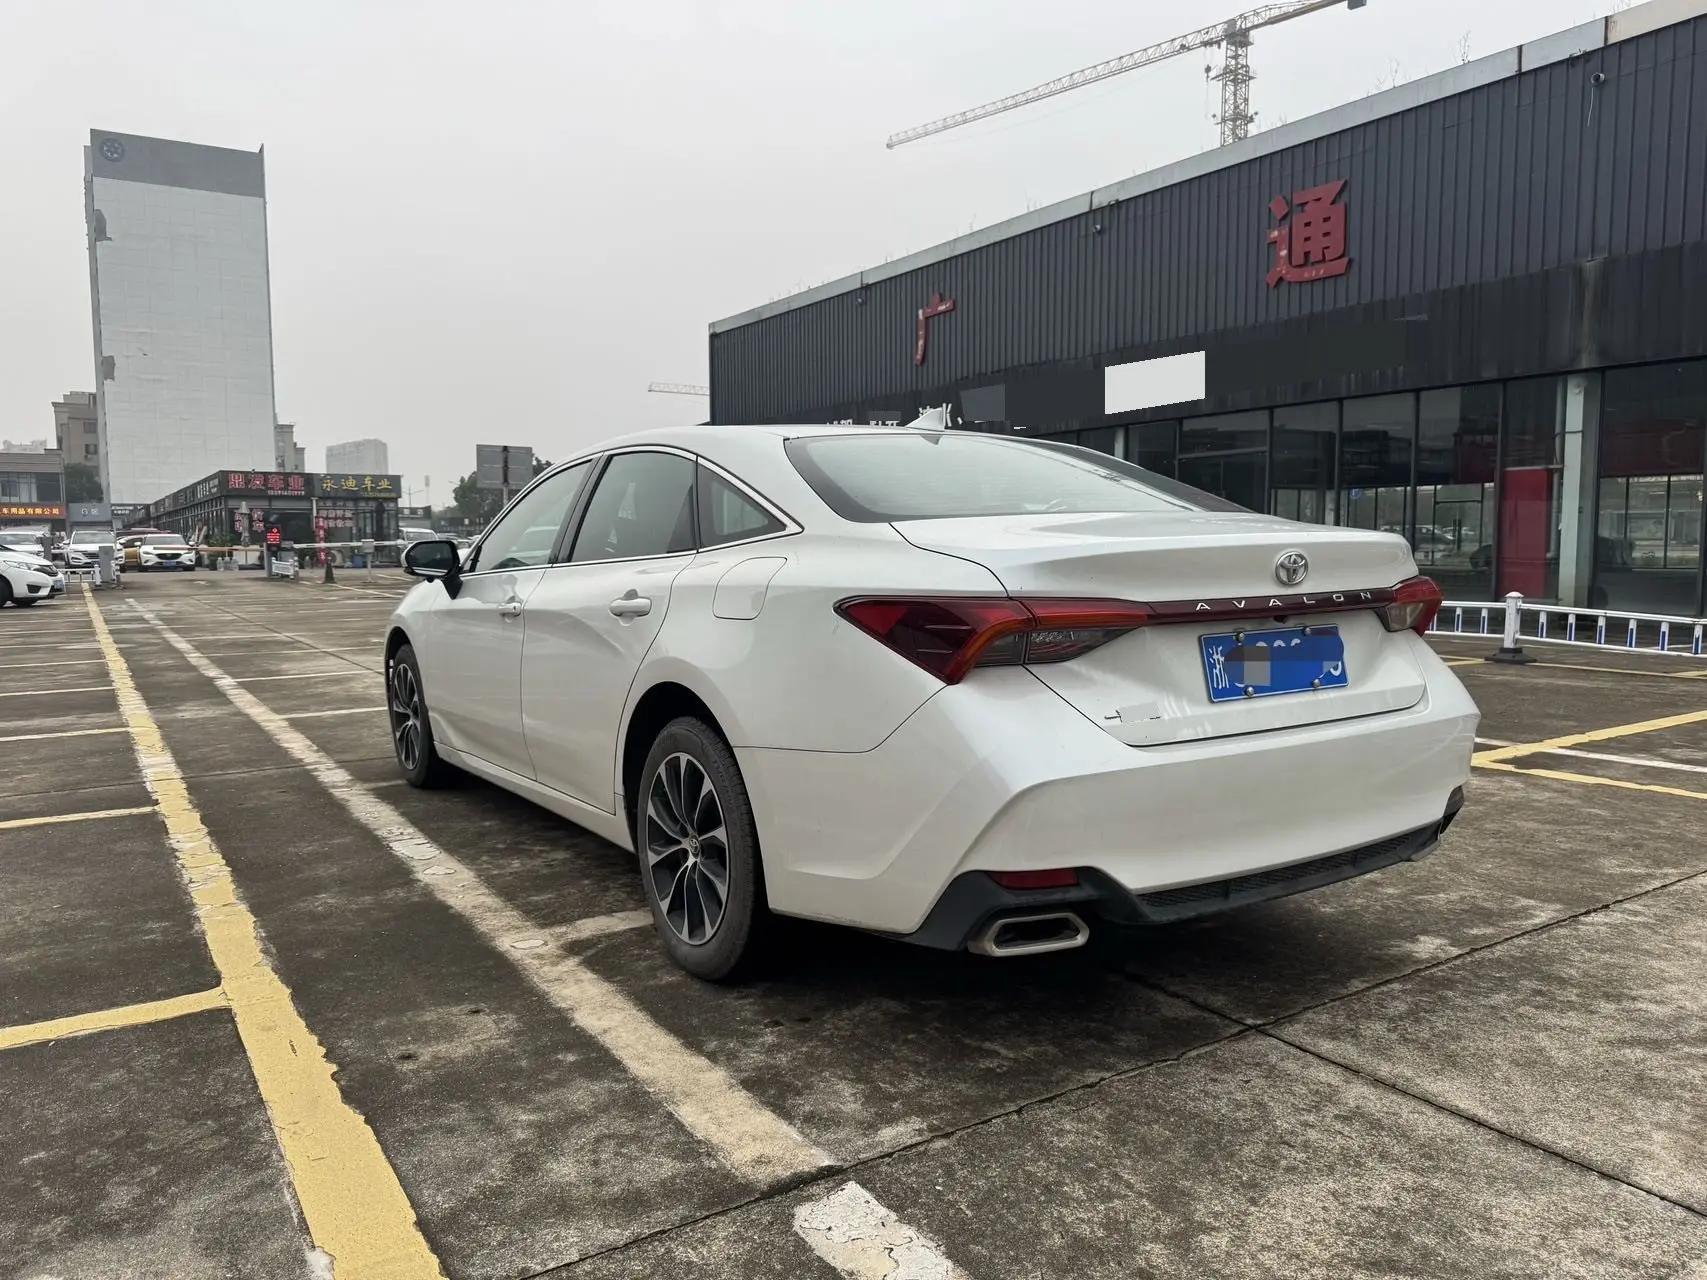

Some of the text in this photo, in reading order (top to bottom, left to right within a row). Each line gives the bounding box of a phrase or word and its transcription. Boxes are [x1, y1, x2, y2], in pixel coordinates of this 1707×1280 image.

[914, 178, 1352, 366] 广 通
[1195, 591, 1372, 611] AVALON
